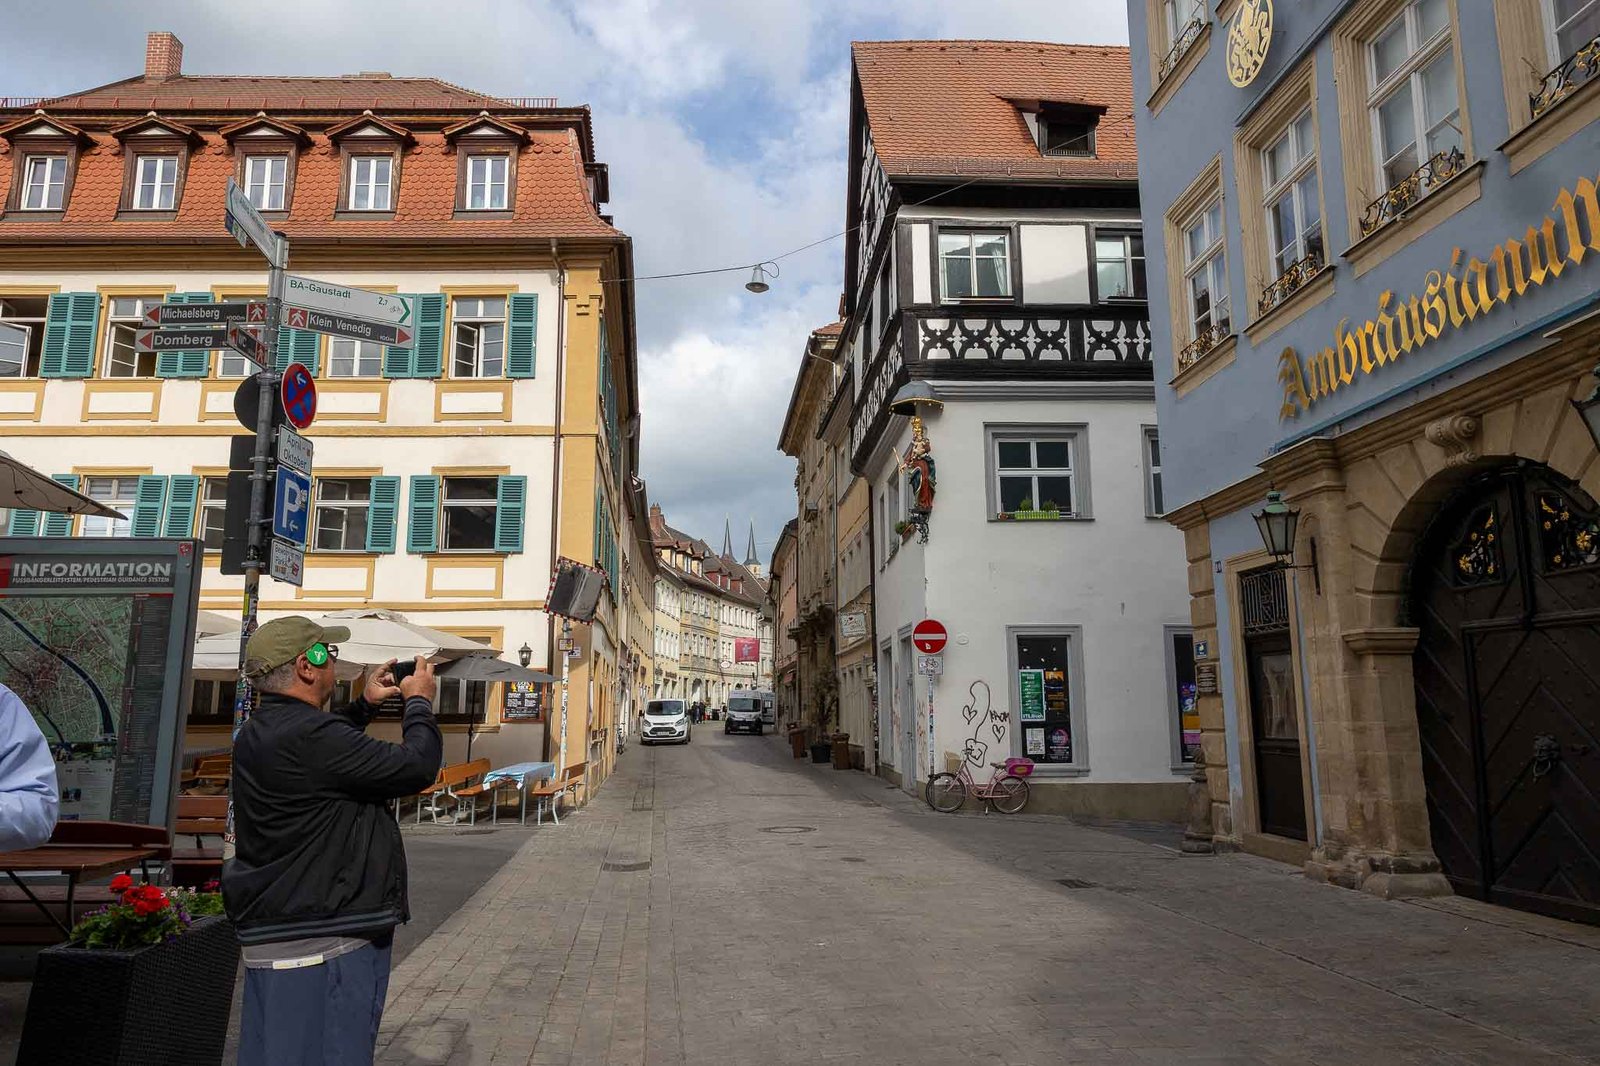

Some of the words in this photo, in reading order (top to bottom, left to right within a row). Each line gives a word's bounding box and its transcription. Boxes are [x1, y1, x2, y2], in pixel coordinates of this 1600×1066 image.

[290, 280, 351, 299] BA-Gaustadt
[162, 308, 220, 320] Michaelsberg
[309, 314, 332, 328] Klein
[336, 319, 372, 336] Venedig
[154, 335, 213, 347] Domberg
[287, 434, 302, 451] April
[284, 449, 306, 470] Oktober
[282, 478, 301, 528] P
[13, 563, 171, 577] INFORMATION
